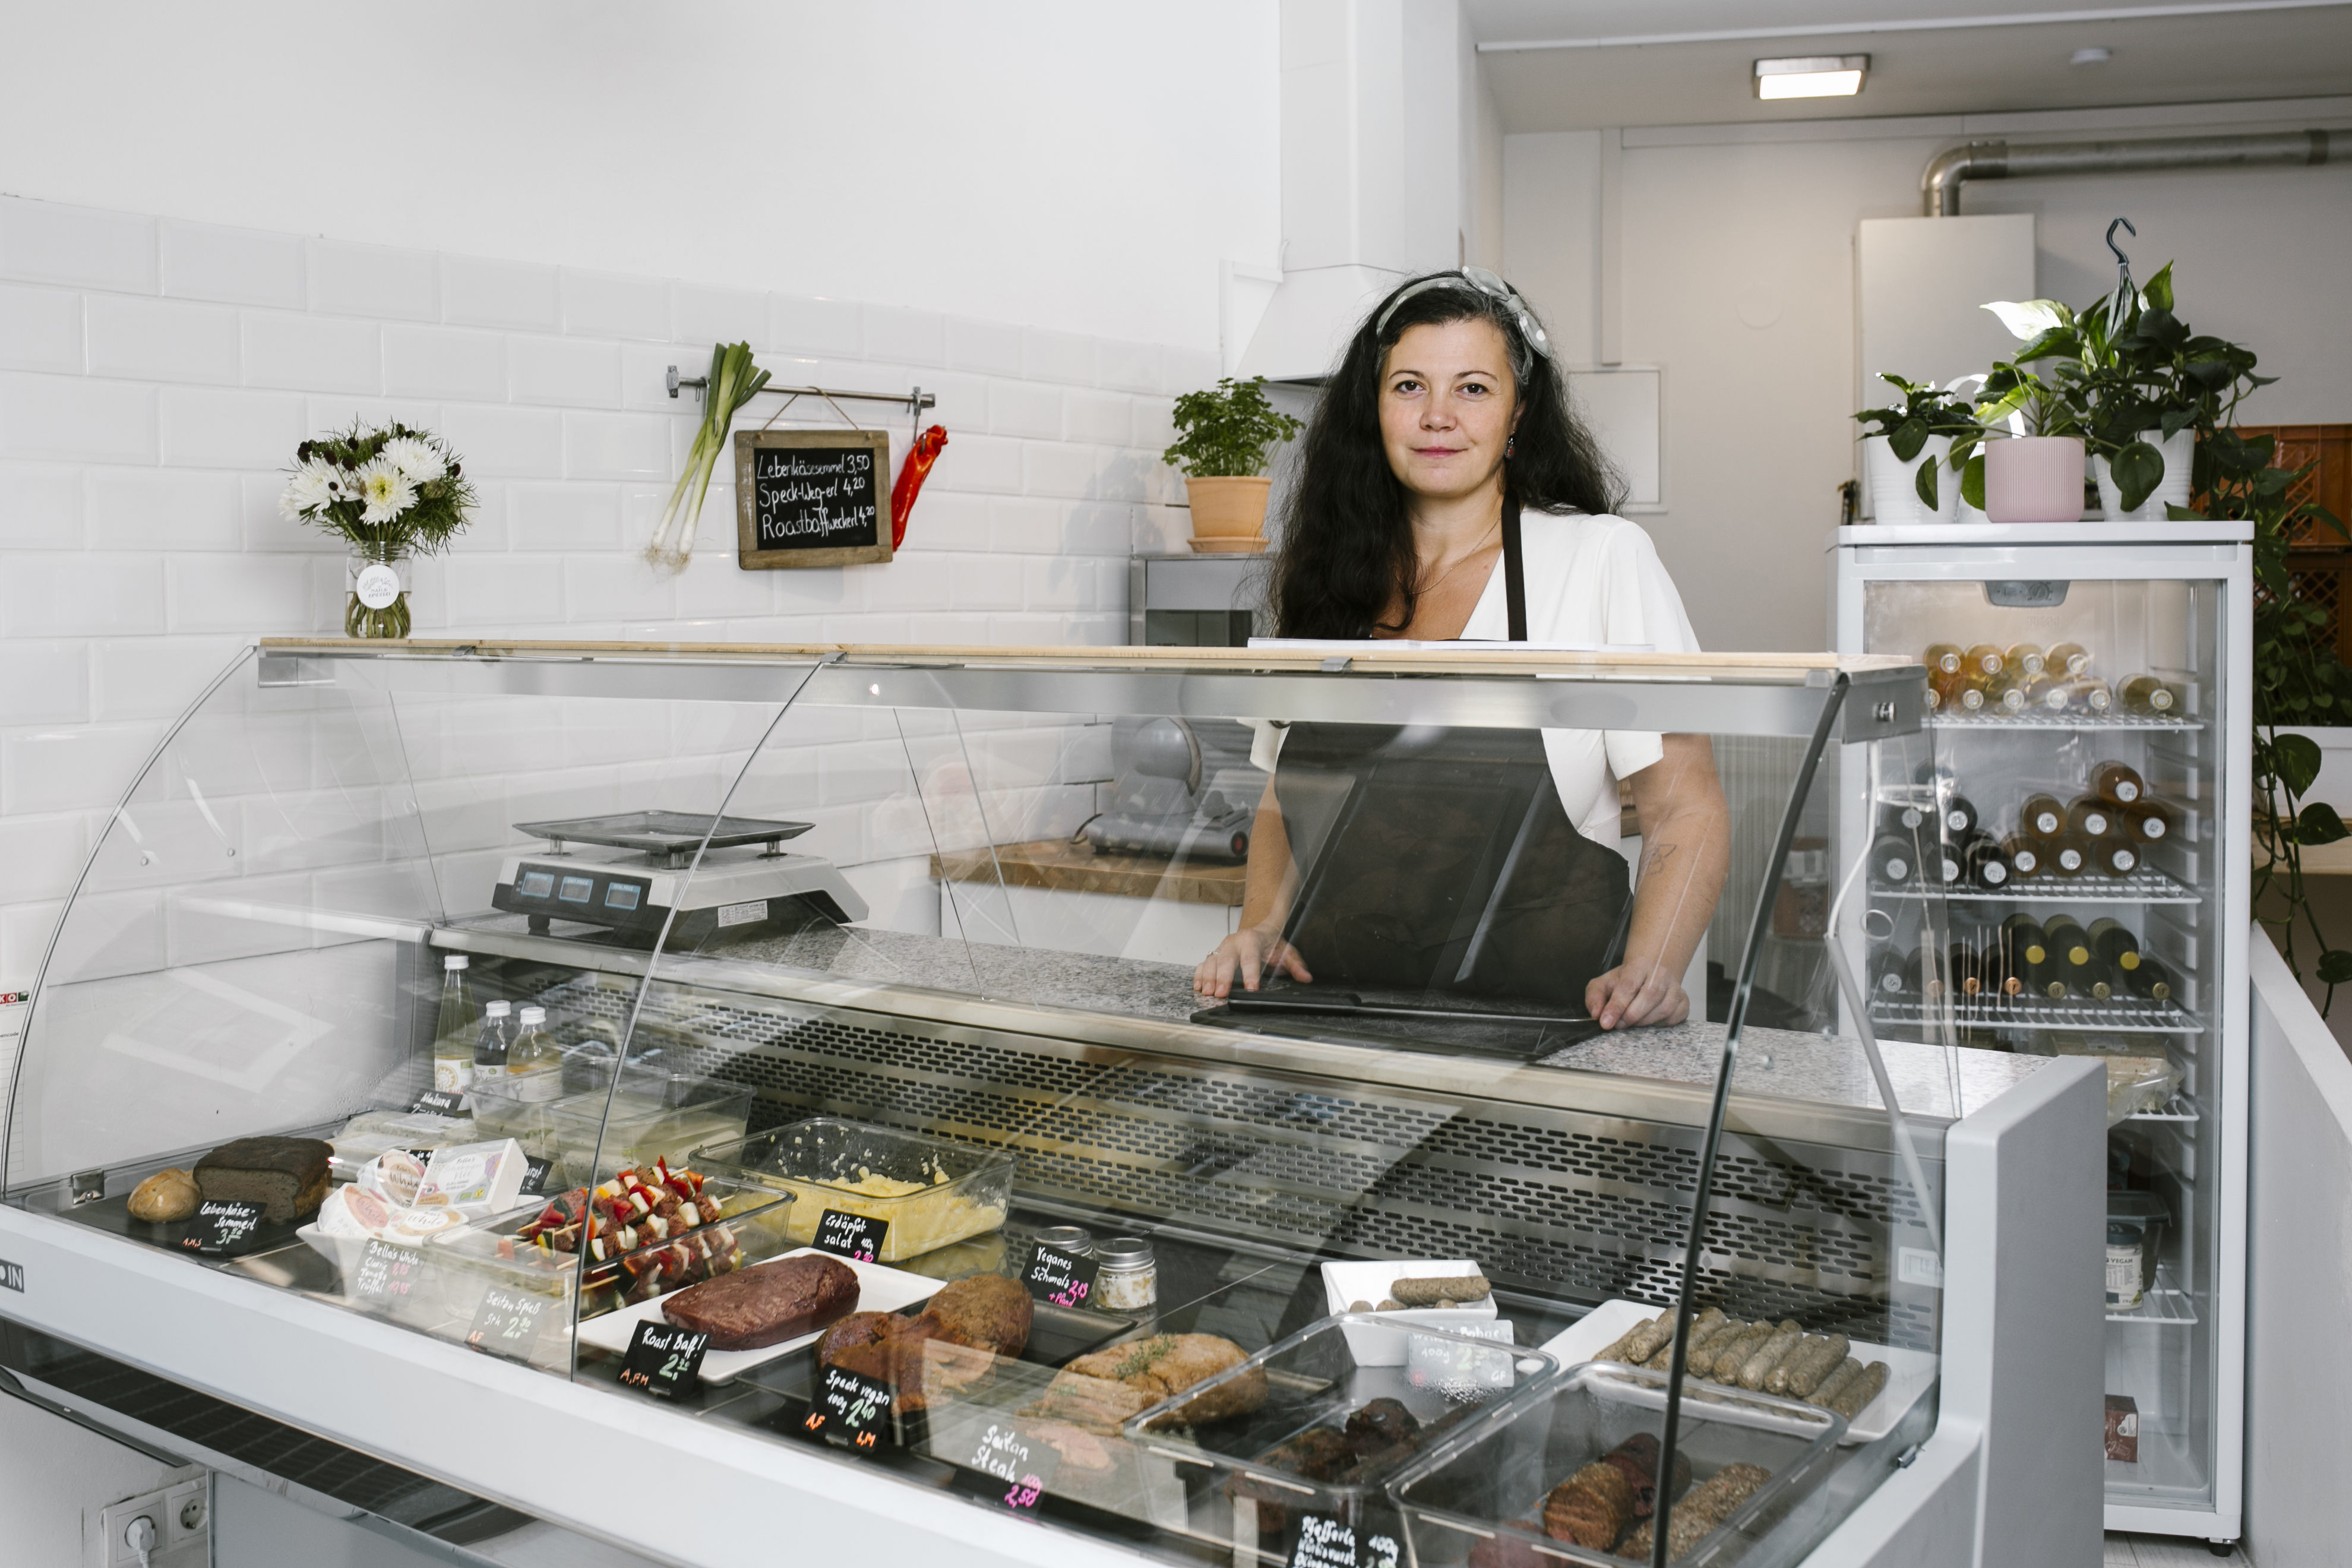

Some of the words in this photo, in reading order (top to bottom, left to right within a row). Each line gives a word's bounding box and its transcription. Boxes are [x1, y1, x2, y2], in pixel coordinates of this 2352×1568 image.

[847, 455, 870, 475] 3,50
[843, 477, 865, 497] 4,20
[859, 506, 875, 527] 4,20
[642, 1326, 672, 1351] Roast
[827, 1392, 848, 1415] 100g
[860, 1385, 890, 1406] vegan
[972, 1444, 1016, 1483] Steak
